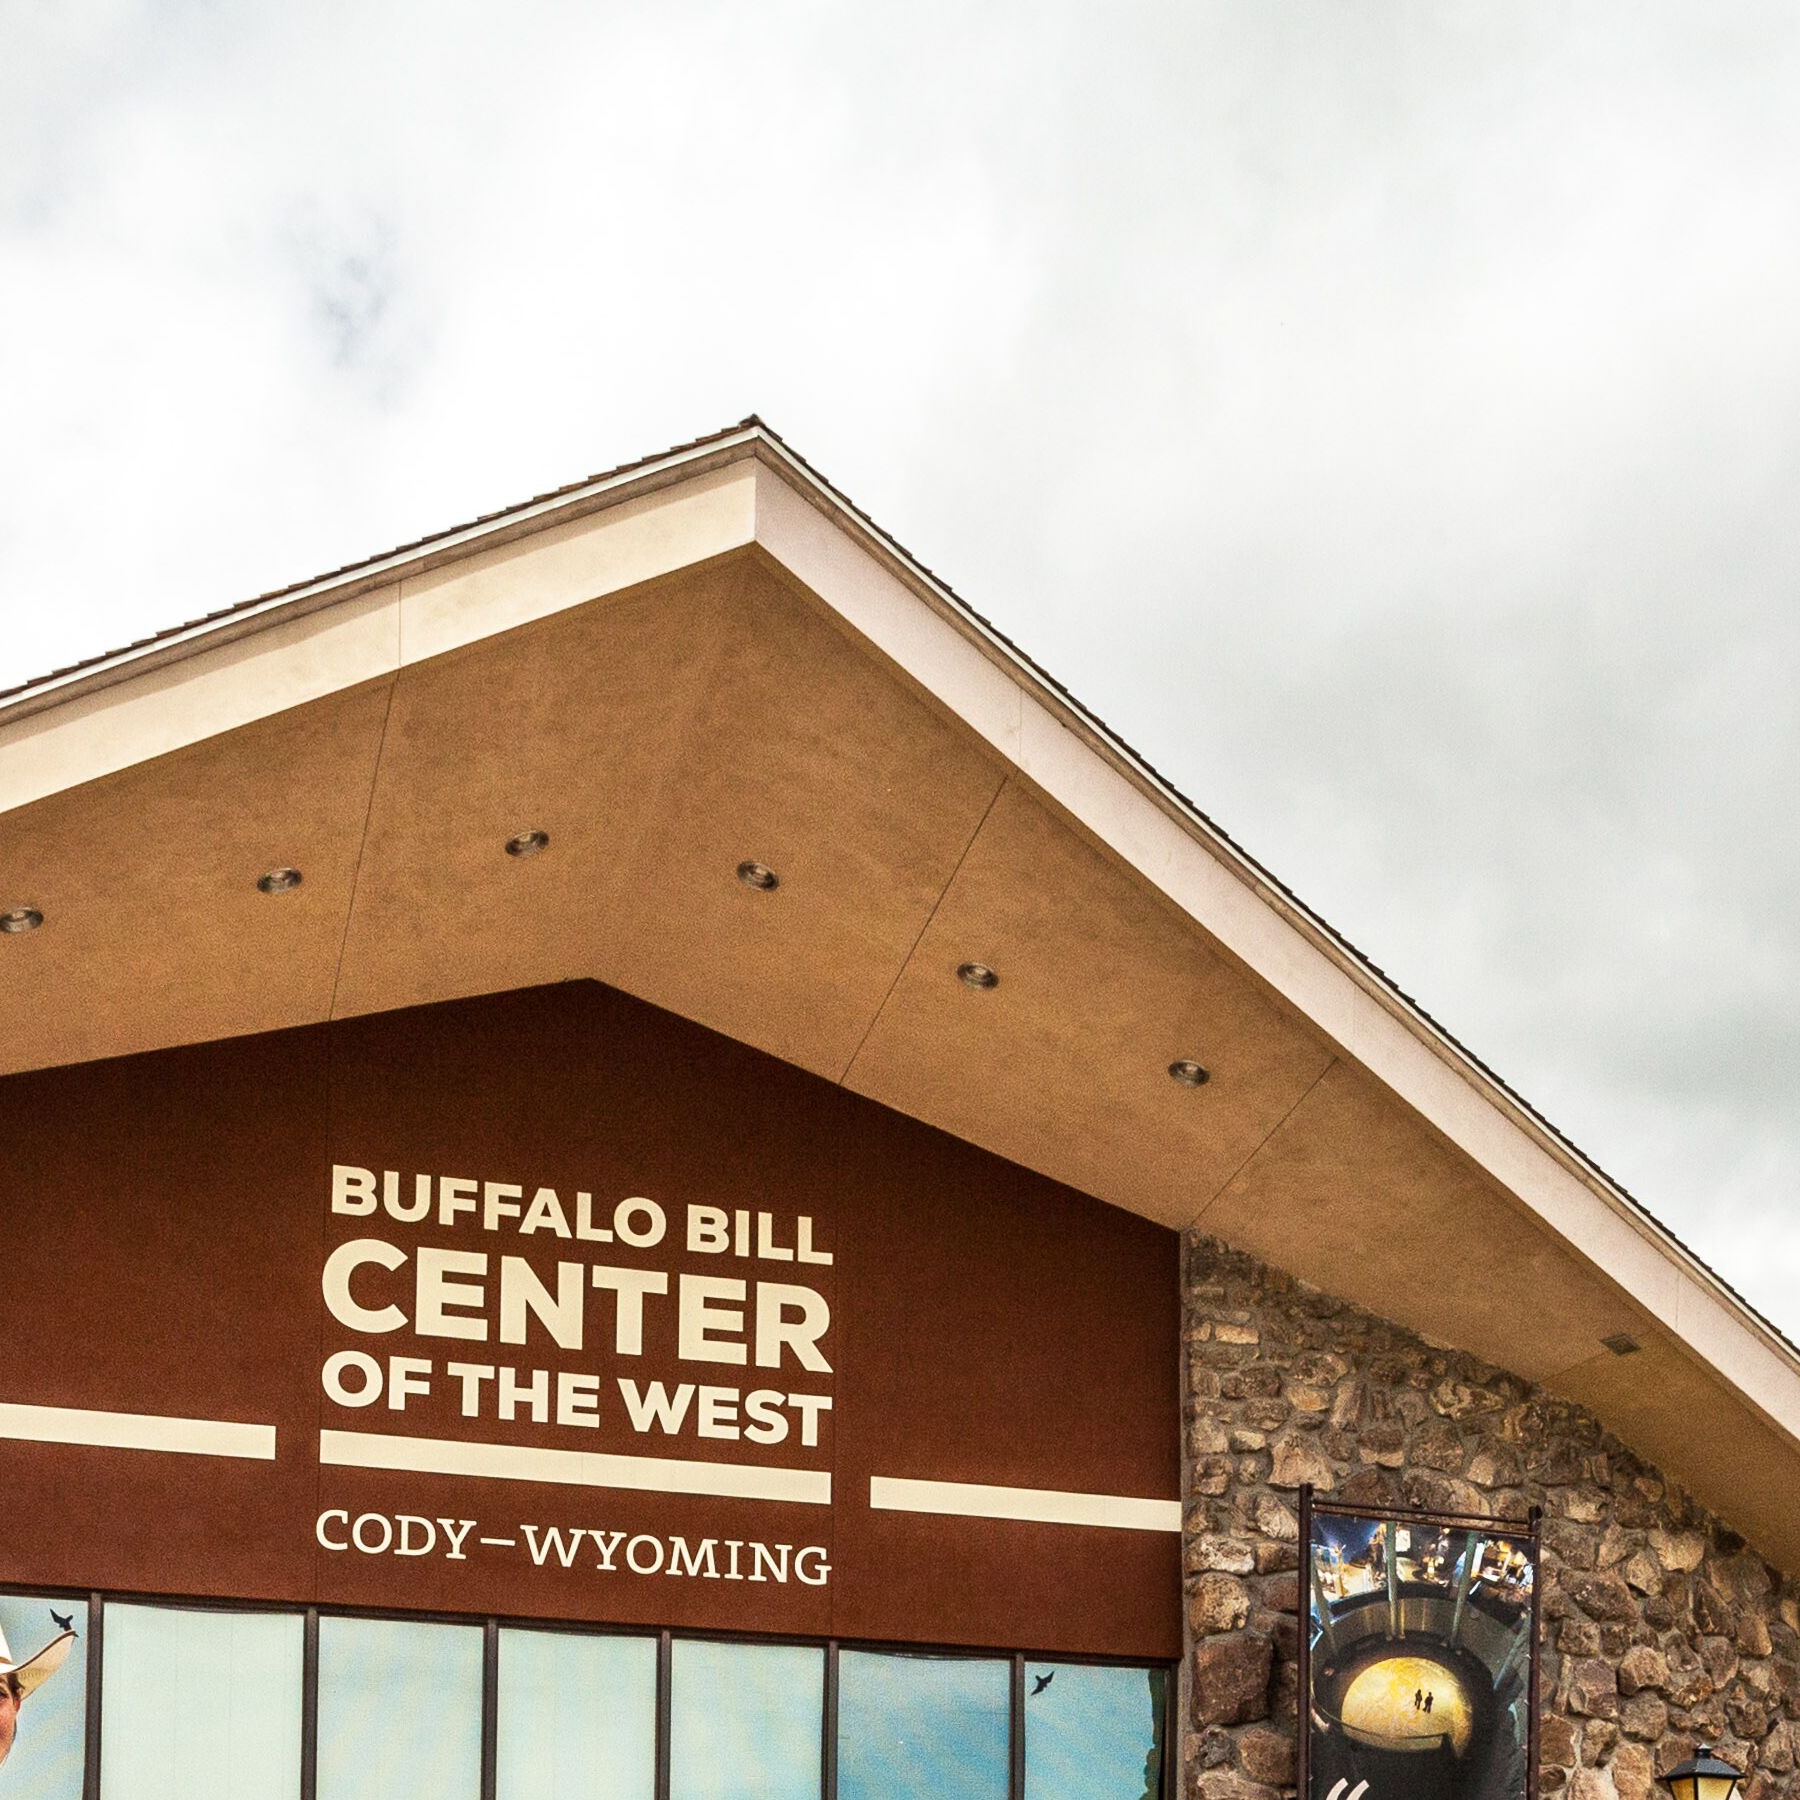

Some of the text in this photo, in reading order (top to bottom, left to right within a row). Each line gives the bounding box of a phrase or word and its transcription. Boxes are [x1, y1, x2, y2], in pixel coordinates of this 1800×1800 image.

[331, 1164, 834, 1266] BUFFALO BILL
[321, 1238, 834, 1374] CENTER
[321, 1350, 834, 1447] OF THE WEST
